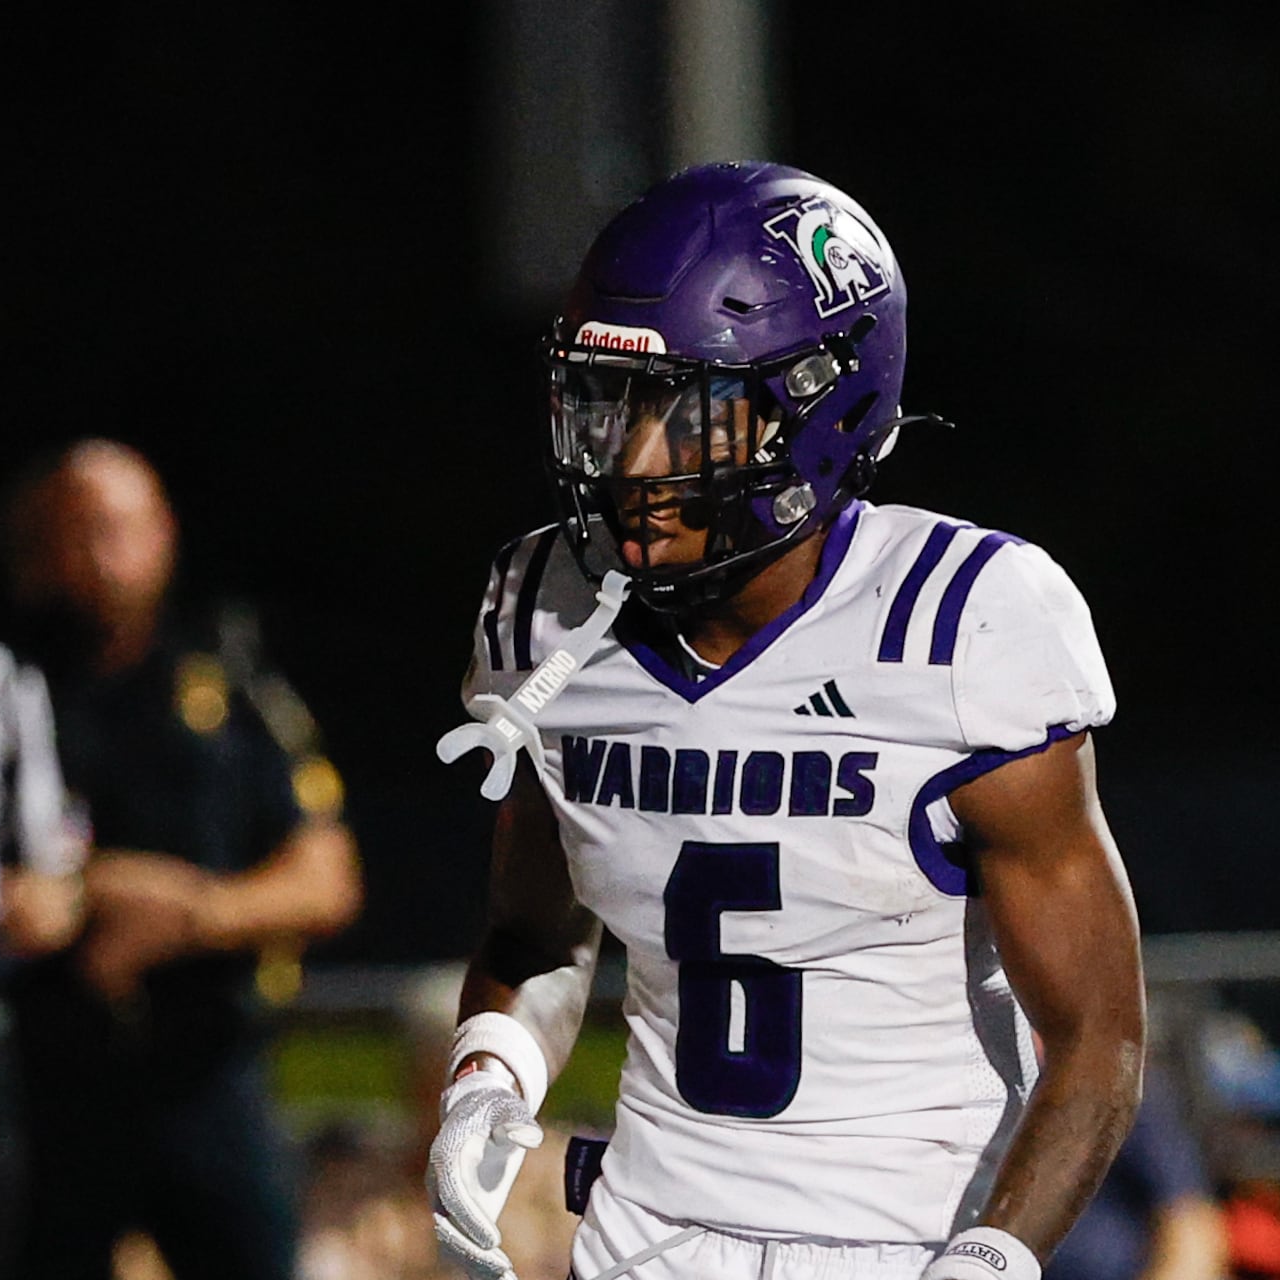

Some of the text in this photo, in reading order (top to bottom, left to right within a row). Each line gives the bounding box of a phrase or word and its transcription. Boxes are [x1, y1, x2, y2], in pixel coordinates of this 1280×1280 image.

[581, 329, 649, 353] Riddell
[517, 649, 577, 714] NXTRND
[561, 734, 878, 818] WARRIORS
[663, 840, 803, 1119] 6
[955, 1244, 1002, 1266] BATT
